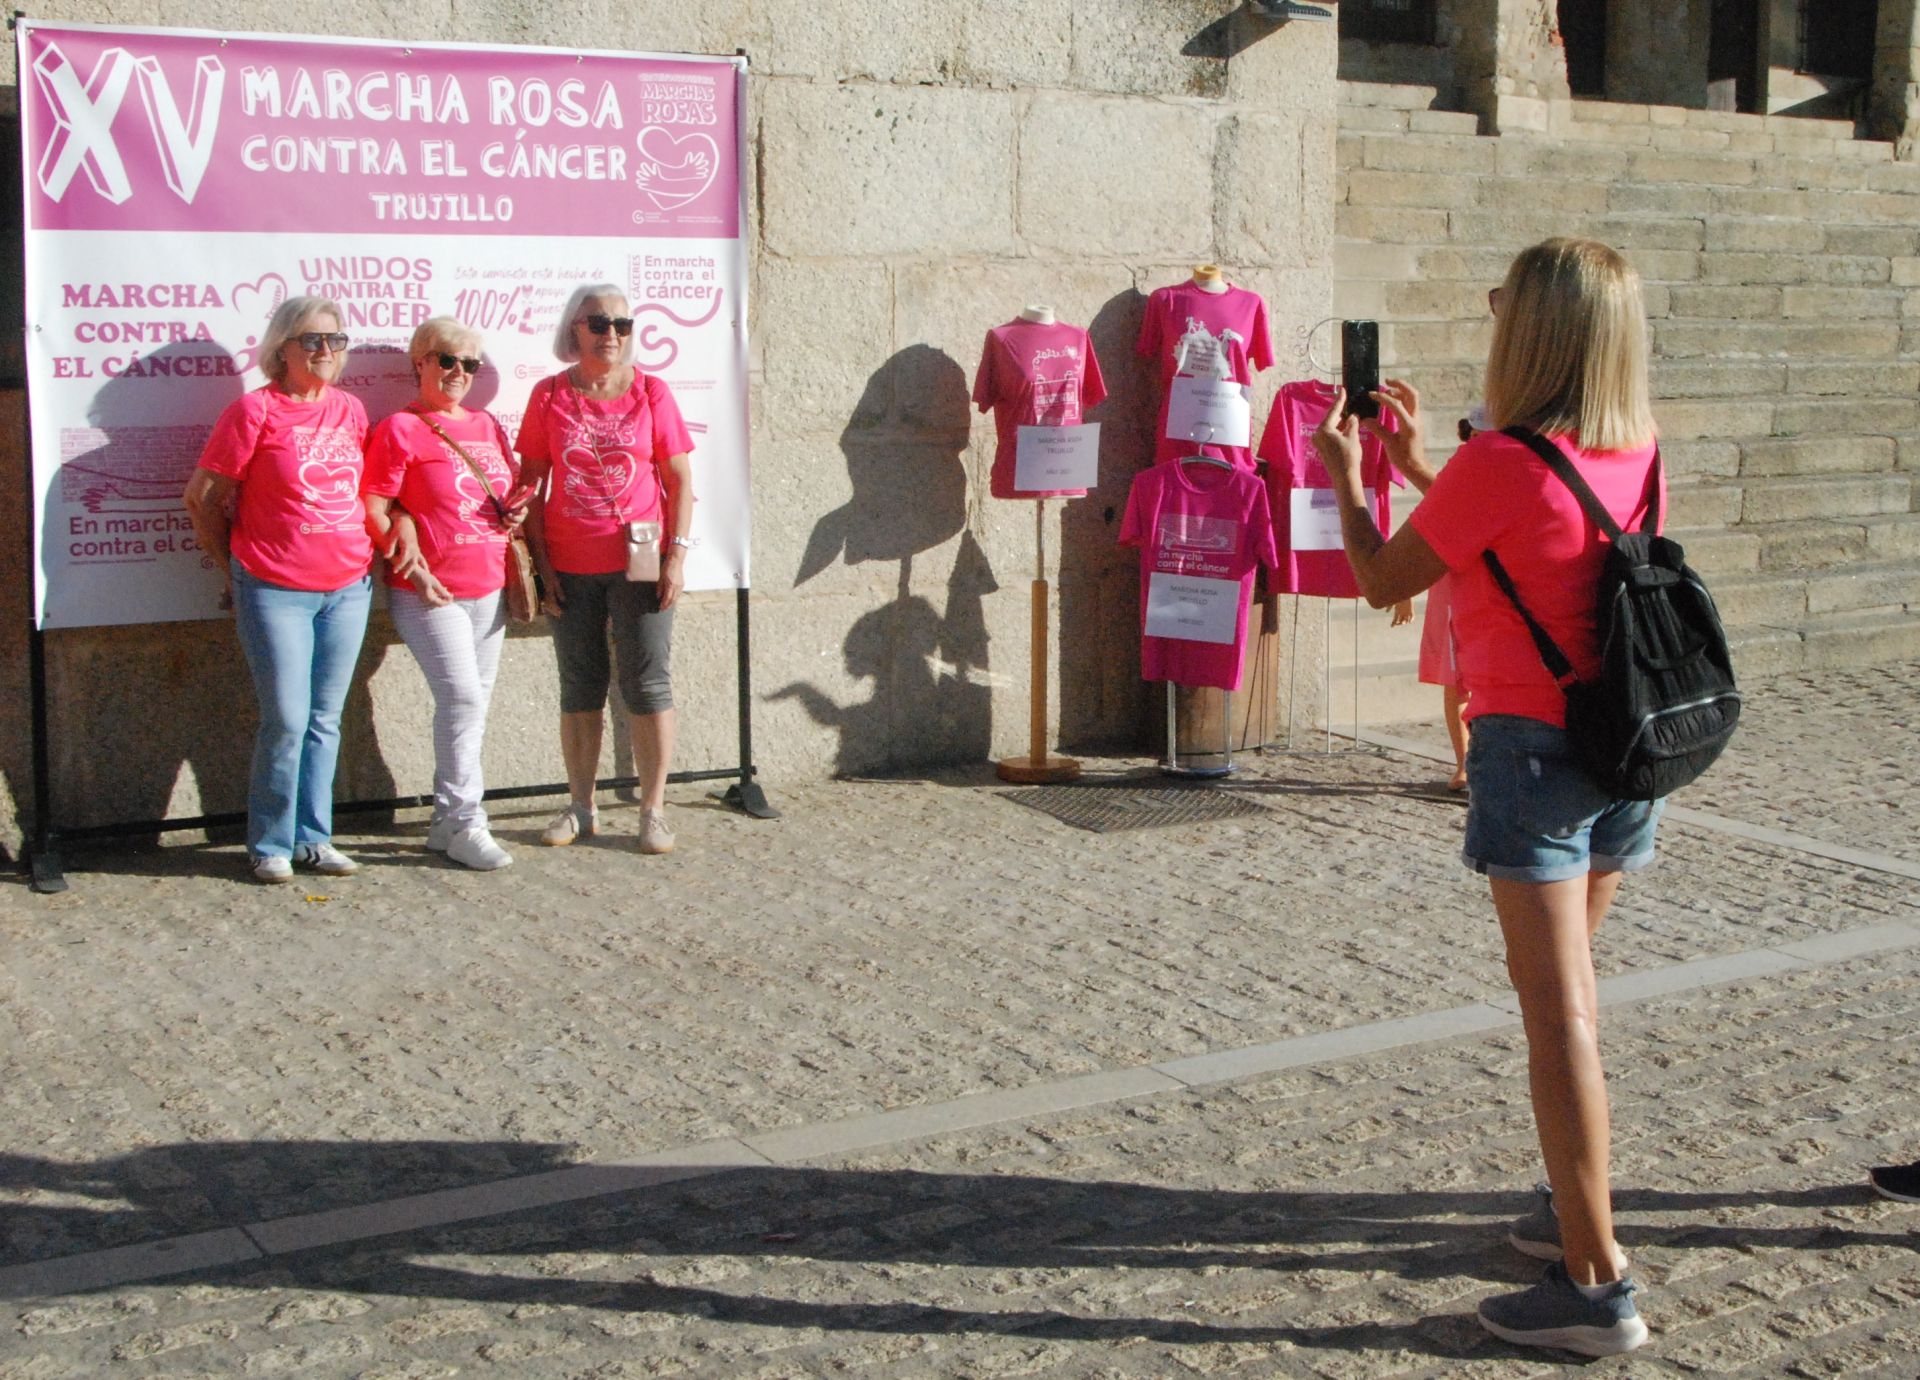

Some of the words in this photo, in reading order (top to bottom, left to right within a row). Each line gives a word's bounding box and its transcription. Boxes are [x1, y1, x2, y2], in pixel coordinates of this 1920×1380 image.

[239, 65, 470, 124] MARCHA
[488, 75, 624, 130] ROSA
[640, 82, 716, 102] MARCHAS
[33, 40, 226, 206] XV
[641, 100, 718, 126] ROSAS
[240, 134, 408, 176] CONTRA
[420, 139, 468, 177] EL
[480, 127, 627, 181] CÁNCER
[368, 191, 514, 222] TRUJILLO
[299, 256, 433, 282] UNIDOS
[644, 255, 662, 267] En
[665, 255, 715, 267] marcha
[644, 270, 694, 280] contra
[702, 268, 715, 280] el
[62, 284, 225, 308] MARCHA
[305, 281, 396, 300] CONTRA
[404, 283, 430, 300] EL
[645, 280, 714, 299] cáncer
[455, 285, 520, 331] 100%
[74, 321, 215, 343] CONTRA
[52, 357, 93, 378] EL
[102, 351, 237, 379] CÁNCER
[69, 516, 98, 535] En
[105, 512, 194, 534] marcha
[69, 537, 147, 557] contra
[153, 534, 173, 553] el
